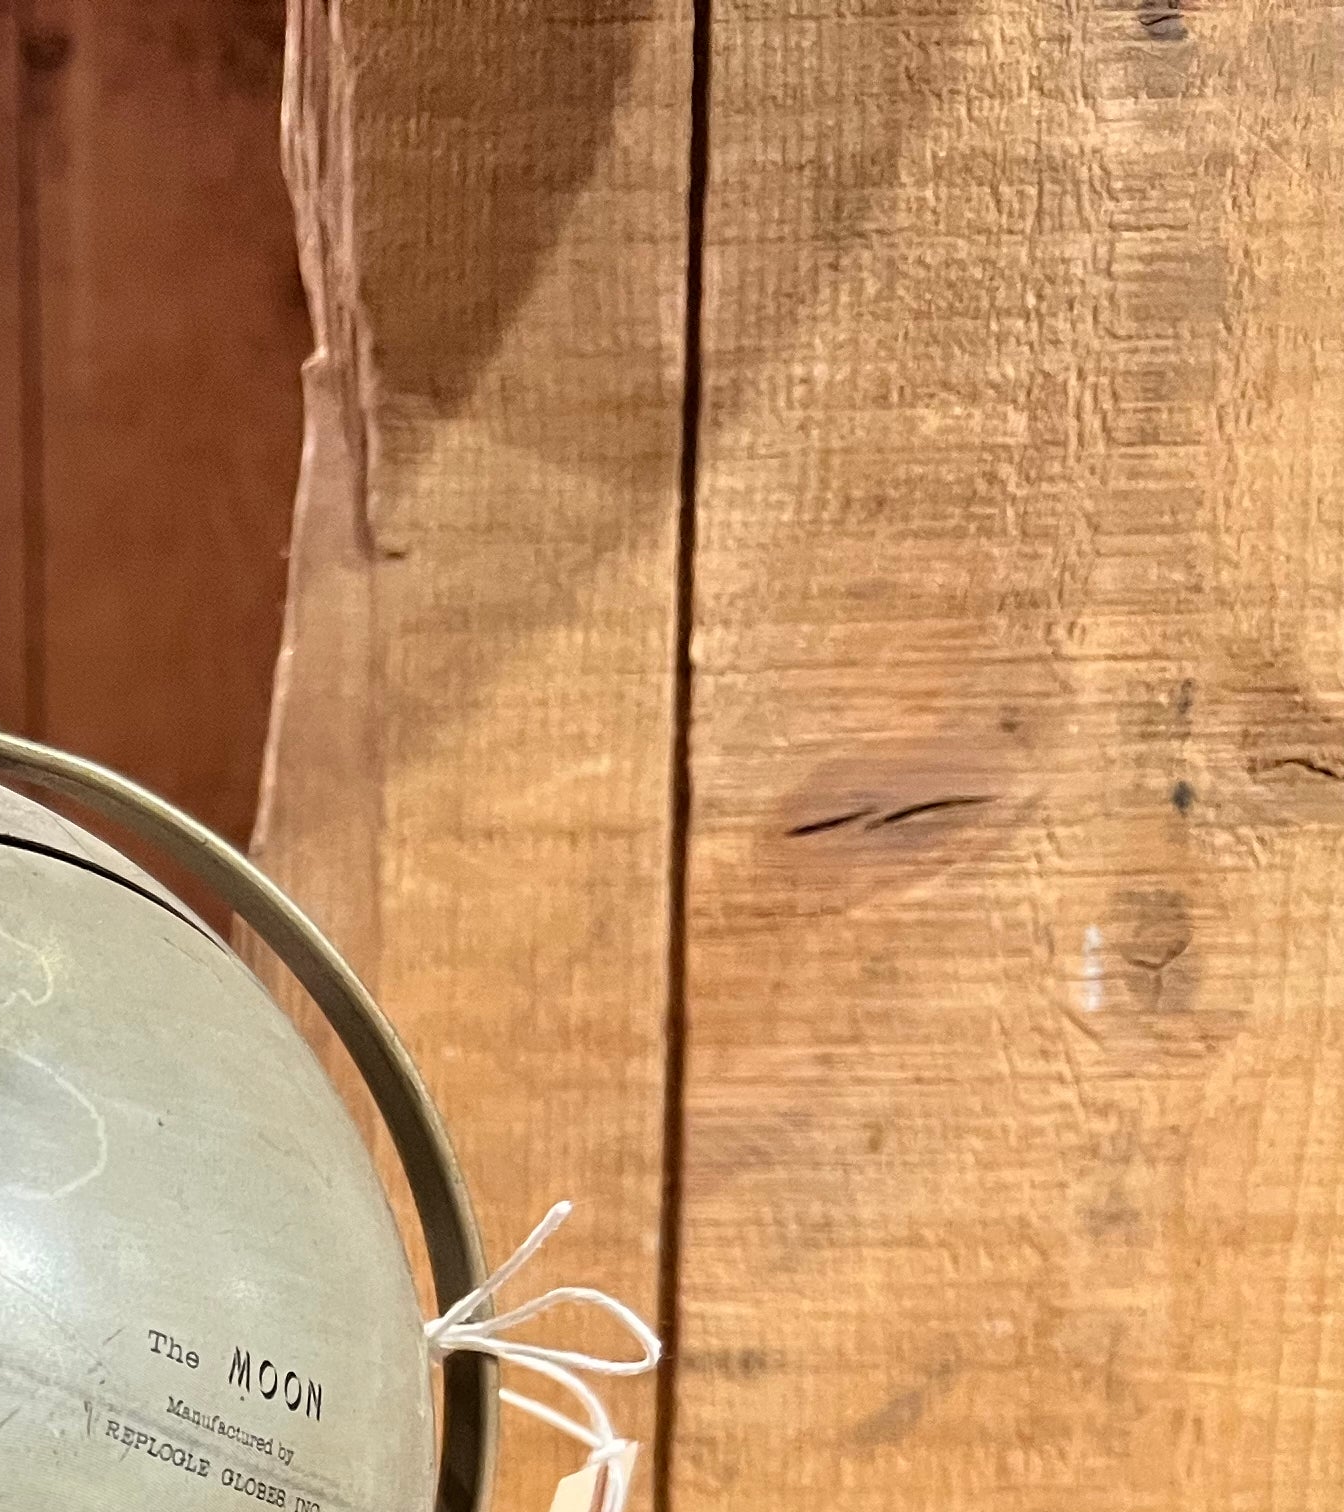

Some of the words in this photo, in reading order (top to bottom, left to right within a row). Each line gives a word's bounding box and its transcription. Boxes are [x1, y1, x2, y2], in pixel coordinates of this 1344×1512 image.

[148, 1329, 201, 1369] The
[229, 1346, 323, 1421] MOON
[106, 1419, 211, 1478] REPLOGLE
[221, 1468, 287, 1509] GLOBES
[166, 1396, 274, 1457] Manufactured
[277, 1441, 295, 1467] by
